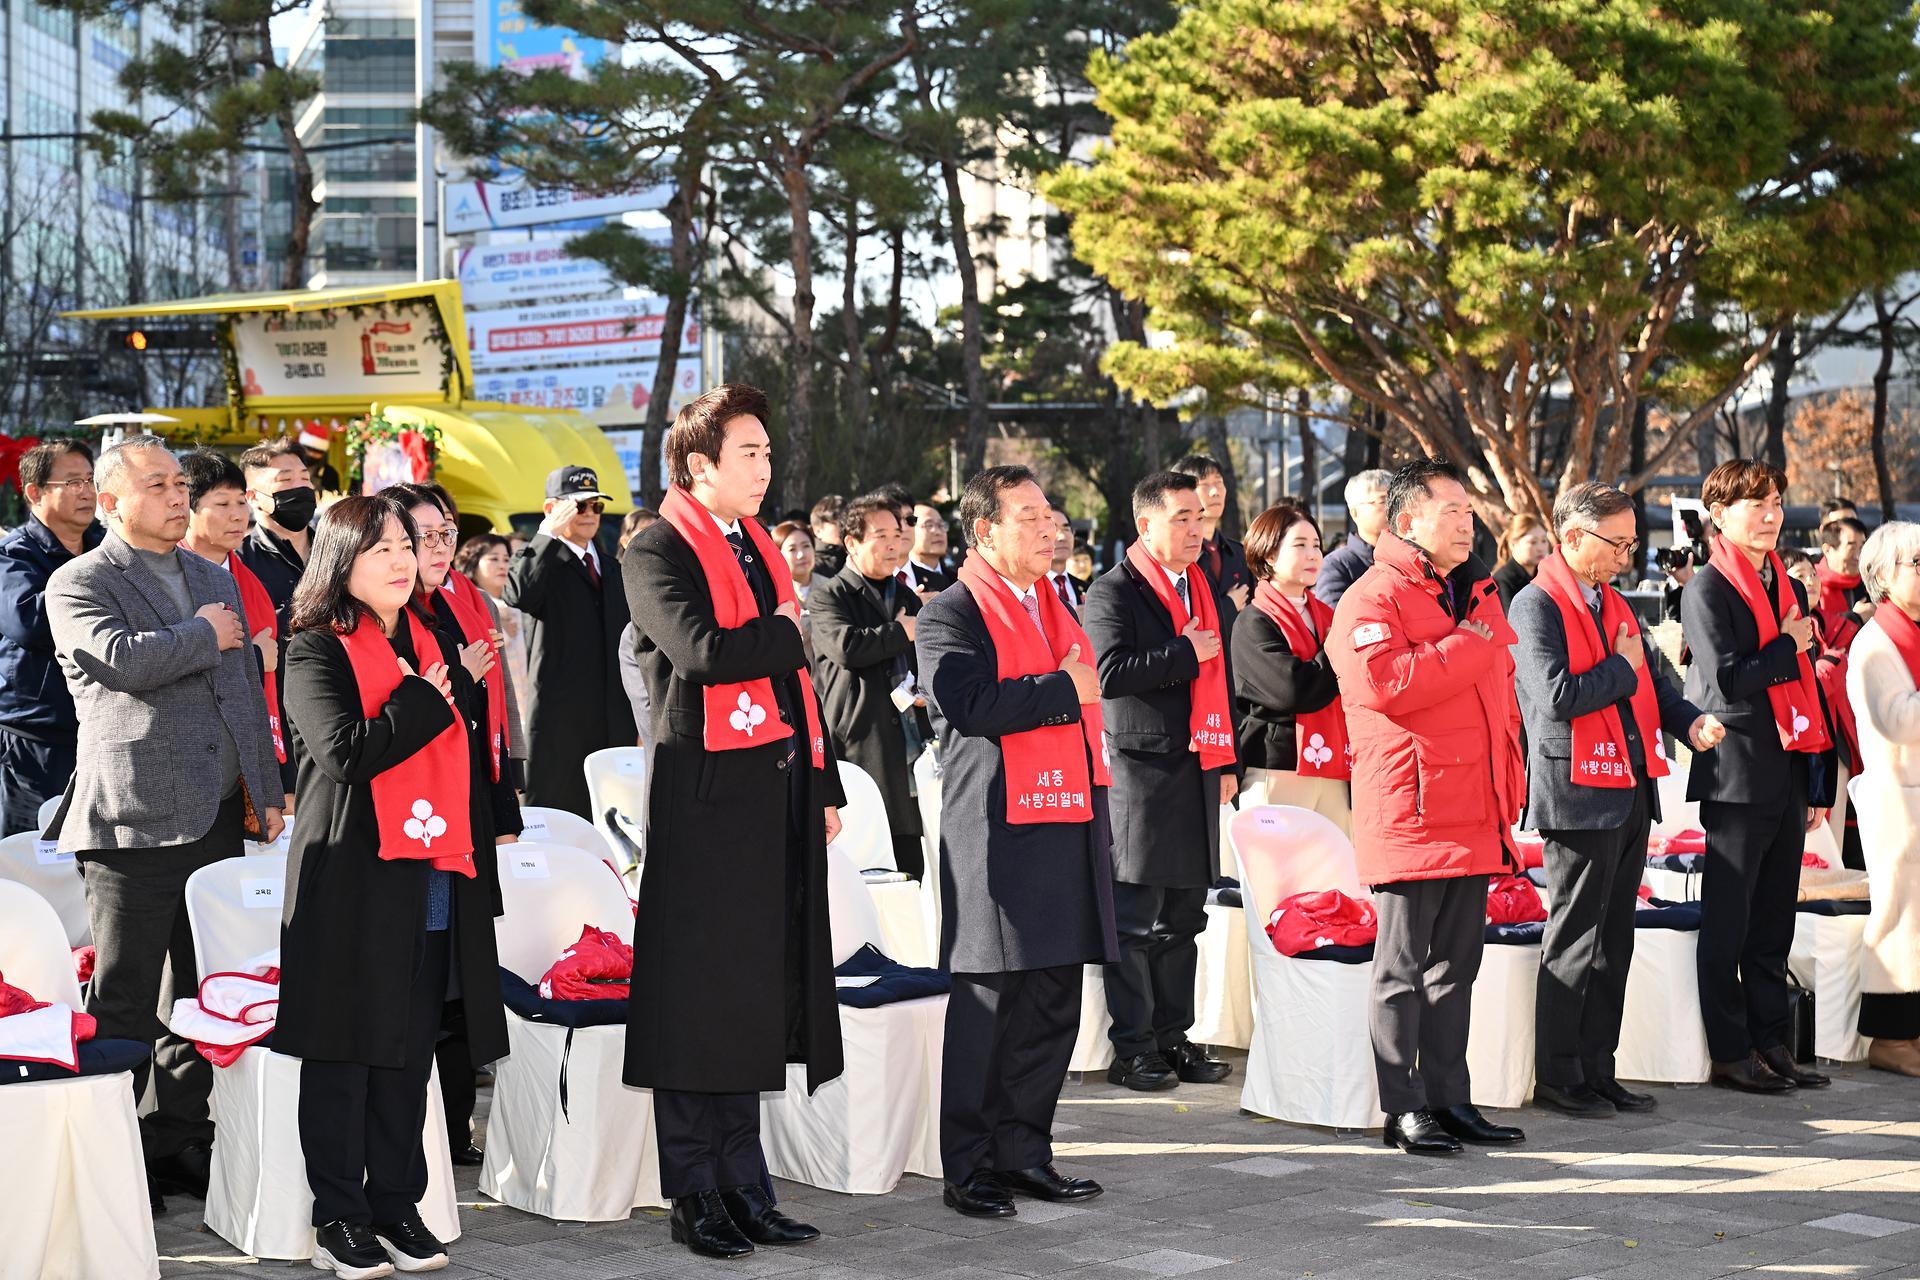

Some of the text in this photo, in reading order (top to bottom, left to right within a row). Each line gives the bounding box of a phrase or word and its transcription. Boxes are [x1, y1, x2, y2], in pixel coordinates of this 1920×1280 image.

[592, 385, 605, 408] 달
[1206, 713, 1221, 728] 세종
[1195, 730, 1232, 747] 사랑의열매
[1593, 742, 1616, 757] 세종
[1036, 769, 1064, 787] 세종
[1018, 791, 1085, 809] 사랑의열매
